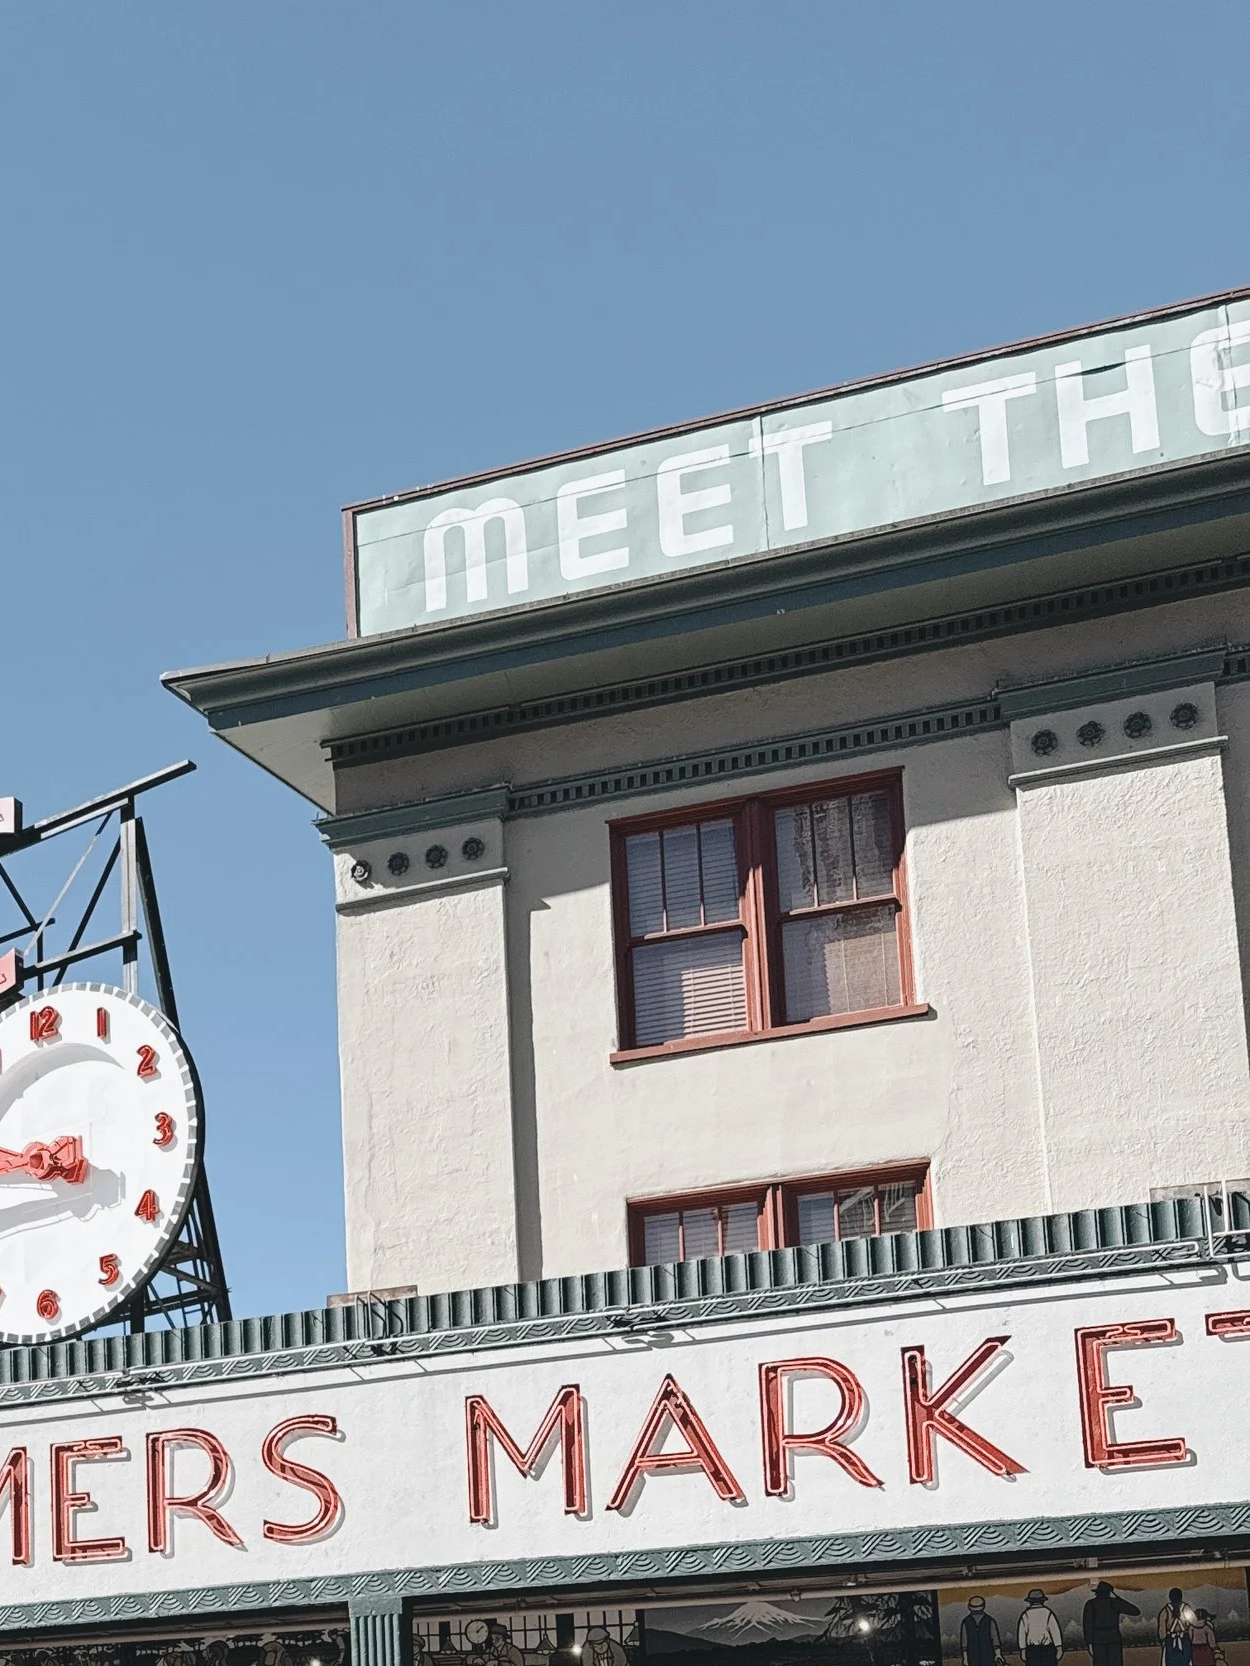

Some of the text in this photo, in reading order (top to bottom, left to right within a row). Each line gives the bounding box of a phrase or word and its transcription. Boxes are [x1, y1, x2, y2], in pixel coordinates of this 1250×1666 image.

[423, 319, 1250, 613] MEET THE
[30, 1006, 59, 1042] 12
[96, 1007, 108, 1040] 1
[137, 1045, 157, 1078] 2
[153, 1112, 174, 1147] 3
[135, 1189, 160, 1222] 4
[98, 1253, 120, 1287] 5
[36, 1289, 59, 1320] 6
